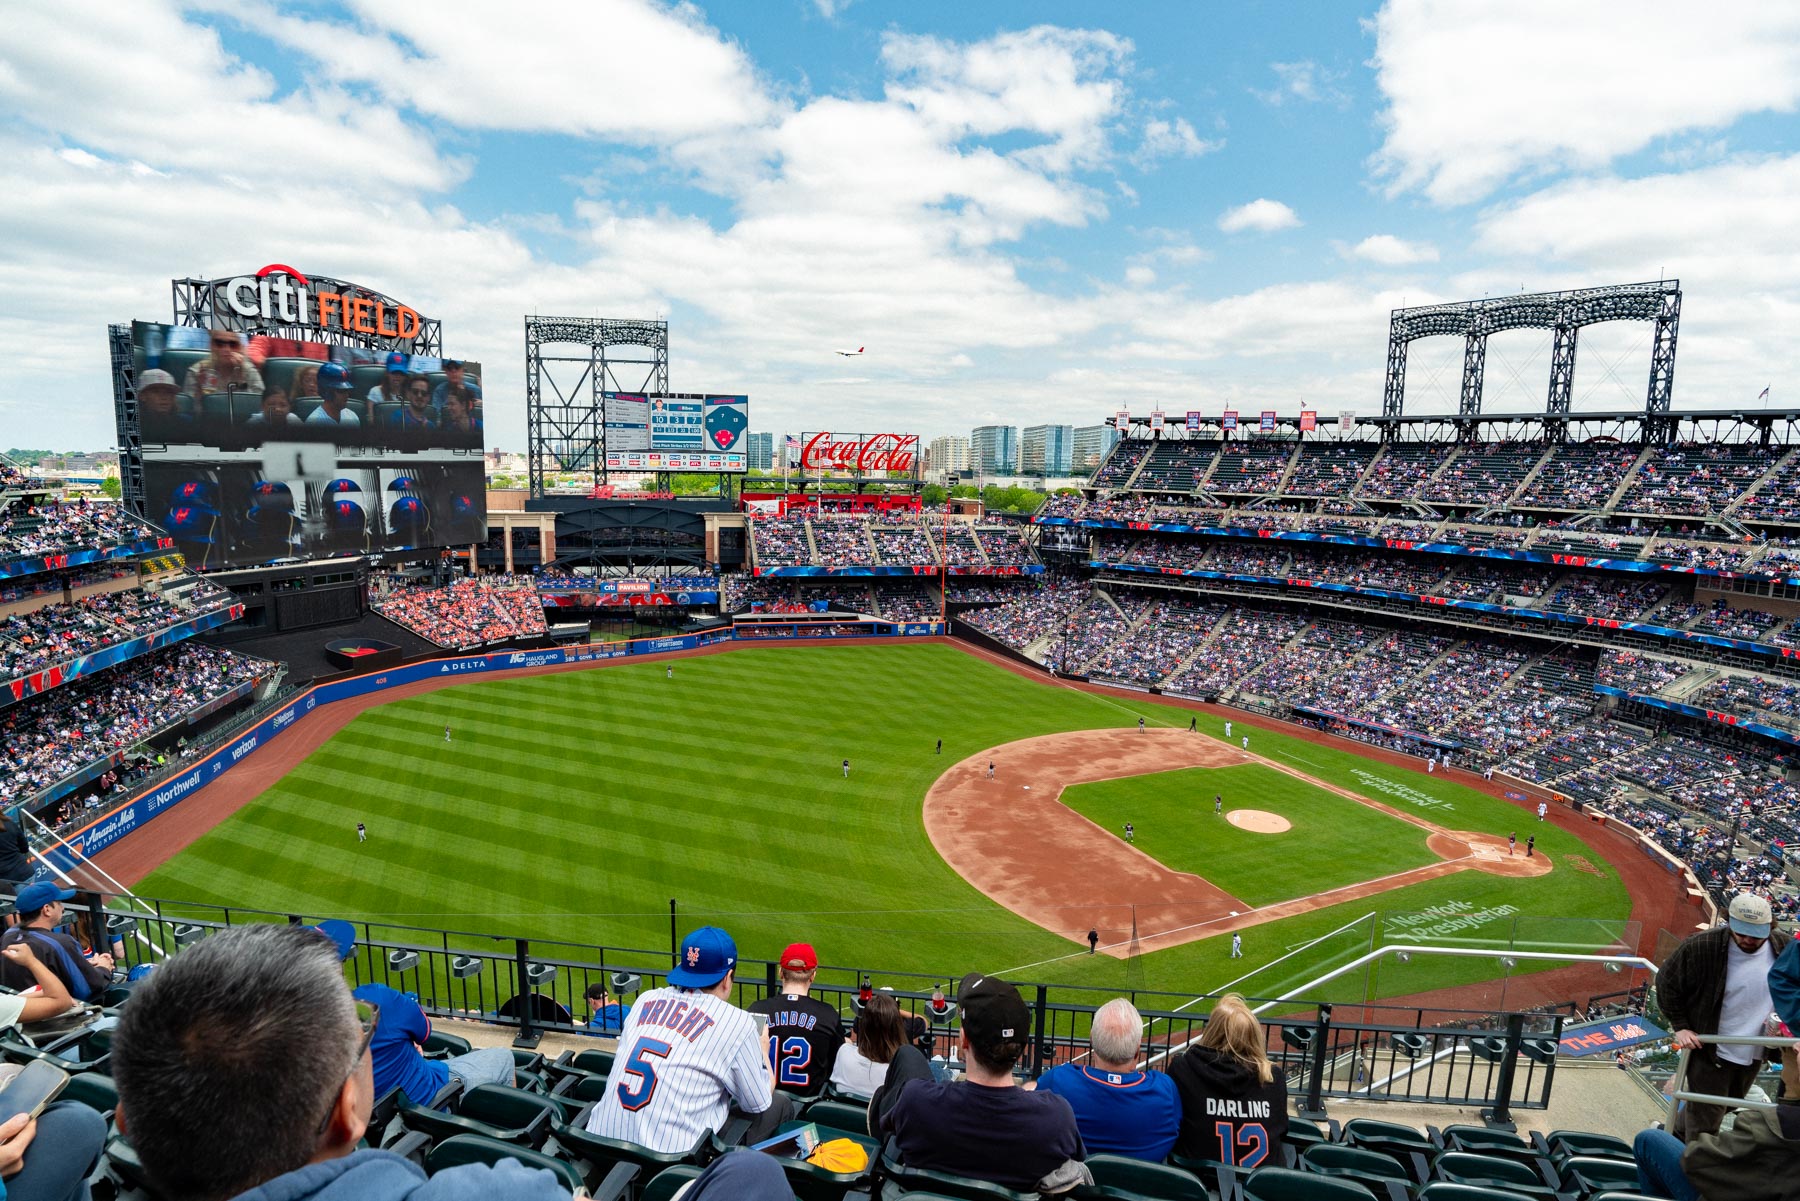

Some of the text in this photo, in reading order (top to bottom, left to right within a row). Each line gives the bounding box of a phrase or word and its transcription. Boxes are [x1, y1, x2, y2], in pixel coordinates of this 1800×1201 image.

[227, 273, 420, 339] citi FIELD
[802, 432, 920, 471] Coca-Cola
[452, 661, 486, 670] DELTA
[232, 737, 256, 760] verizon
[156, 771, 200, 807] Northwell
[118, 808, 135, 827] Mets
[88, 821, 136, 854] FOUNDATION
[36, 861, 50, 878] 35
[1412, 904, 1520, 943] Presbyterian
[637, 999, 714, 1043] WRIGHT
[767, 1010, 817, 1031] LINDOR
[1560, 1024, 1647, 1050] THE Mets
[617, 1036, 672, 1112] 5
[768, 1036, 811, 1086] 12
[1206, 1098, 1271, 1119] DARLING
[1215, 1120, 1270, 1168] 12
